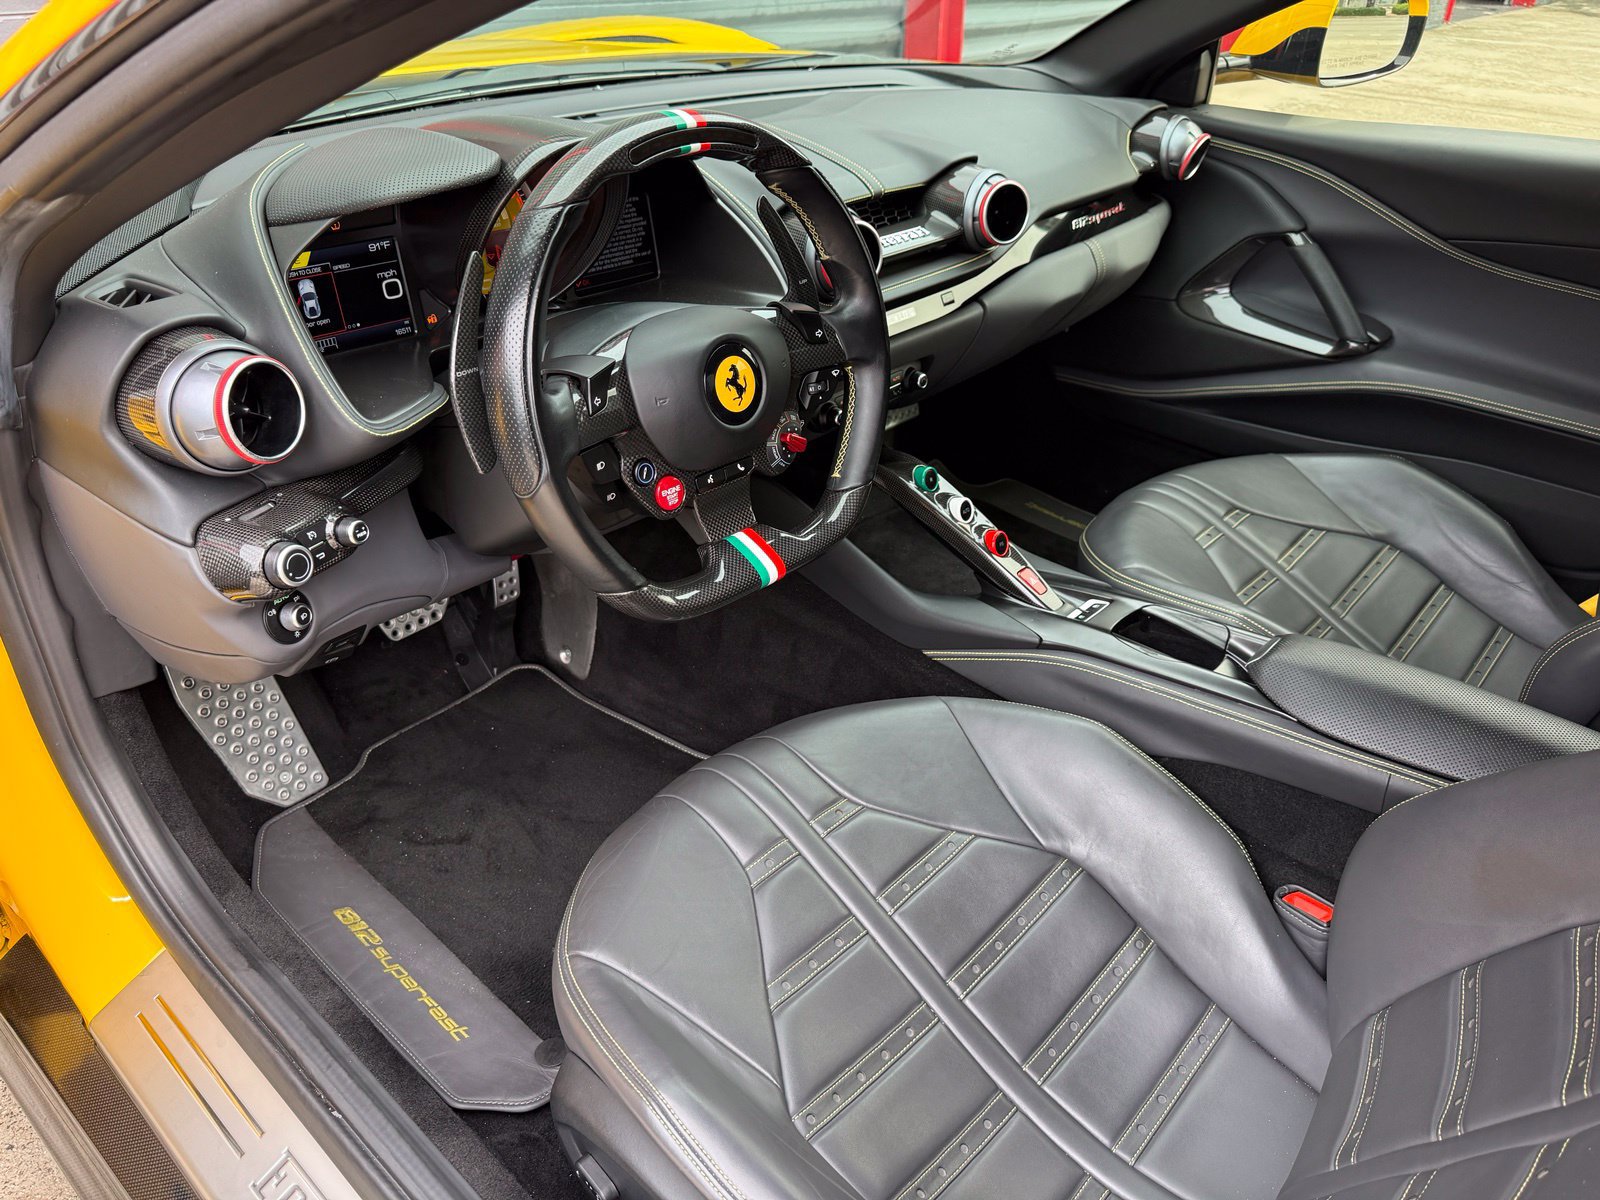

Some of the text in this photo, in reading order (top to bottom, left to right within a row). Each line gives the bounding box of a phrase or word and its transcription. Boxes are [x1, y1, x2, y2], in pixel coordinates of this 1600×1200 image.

[368, 240, 391, 252] 91°F
[306, 266, 322, 275] CLOSE
[376, 268, 398, 279] mph
[798, 278, 808, 286] UP
[316, 318, 331, 326] open
[395, 326, 412, 336] 16511
[456, 366, 479, 378] DOWN
[661, 484, 681, 497] ENGINE
[273, 594, 290, 606] AUTO
[332, 906, 470, 1042] 812 superfast
